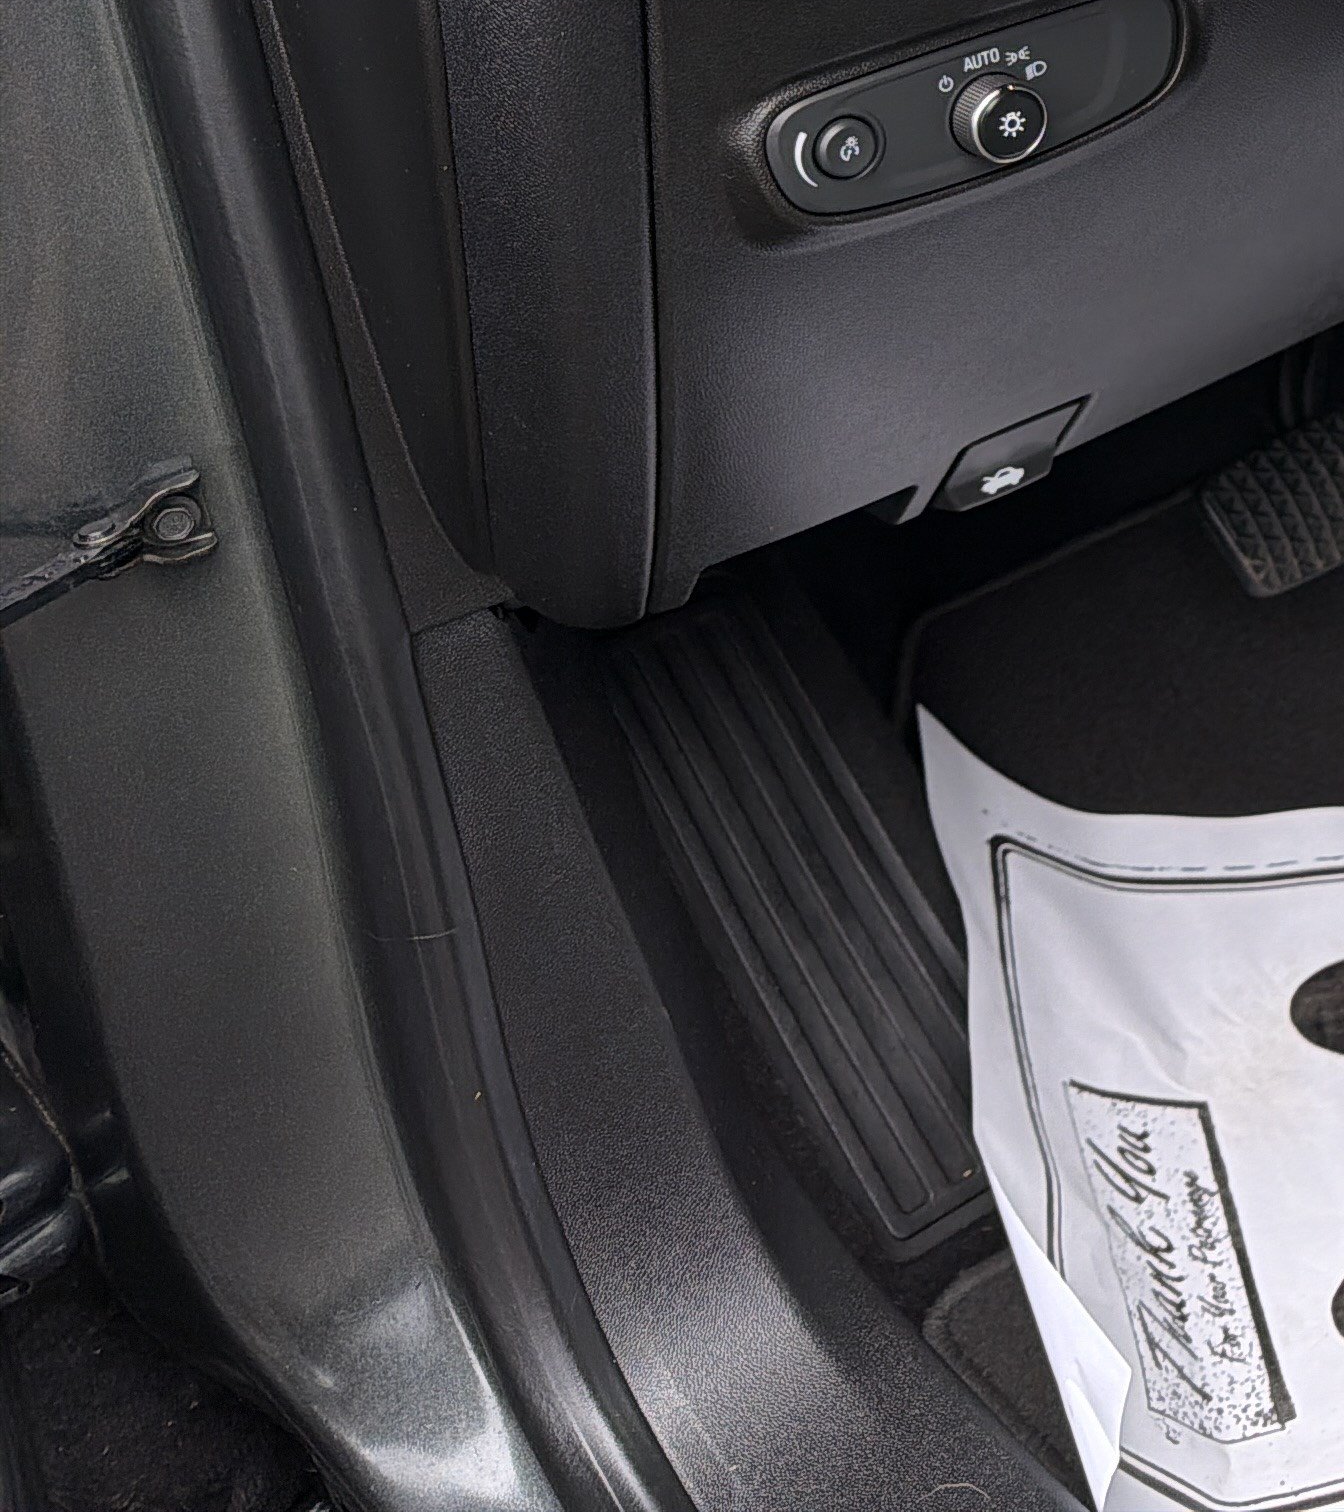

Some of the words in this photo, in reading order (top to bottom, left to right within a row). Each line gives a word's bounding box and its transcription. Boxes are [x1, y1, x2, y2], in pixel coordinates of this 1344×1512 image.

[963, 47, 1001, 73] AUTO
[1085, 1123, 1169, 1202] You
[1106, 1204, 1213, 1402] Thank
